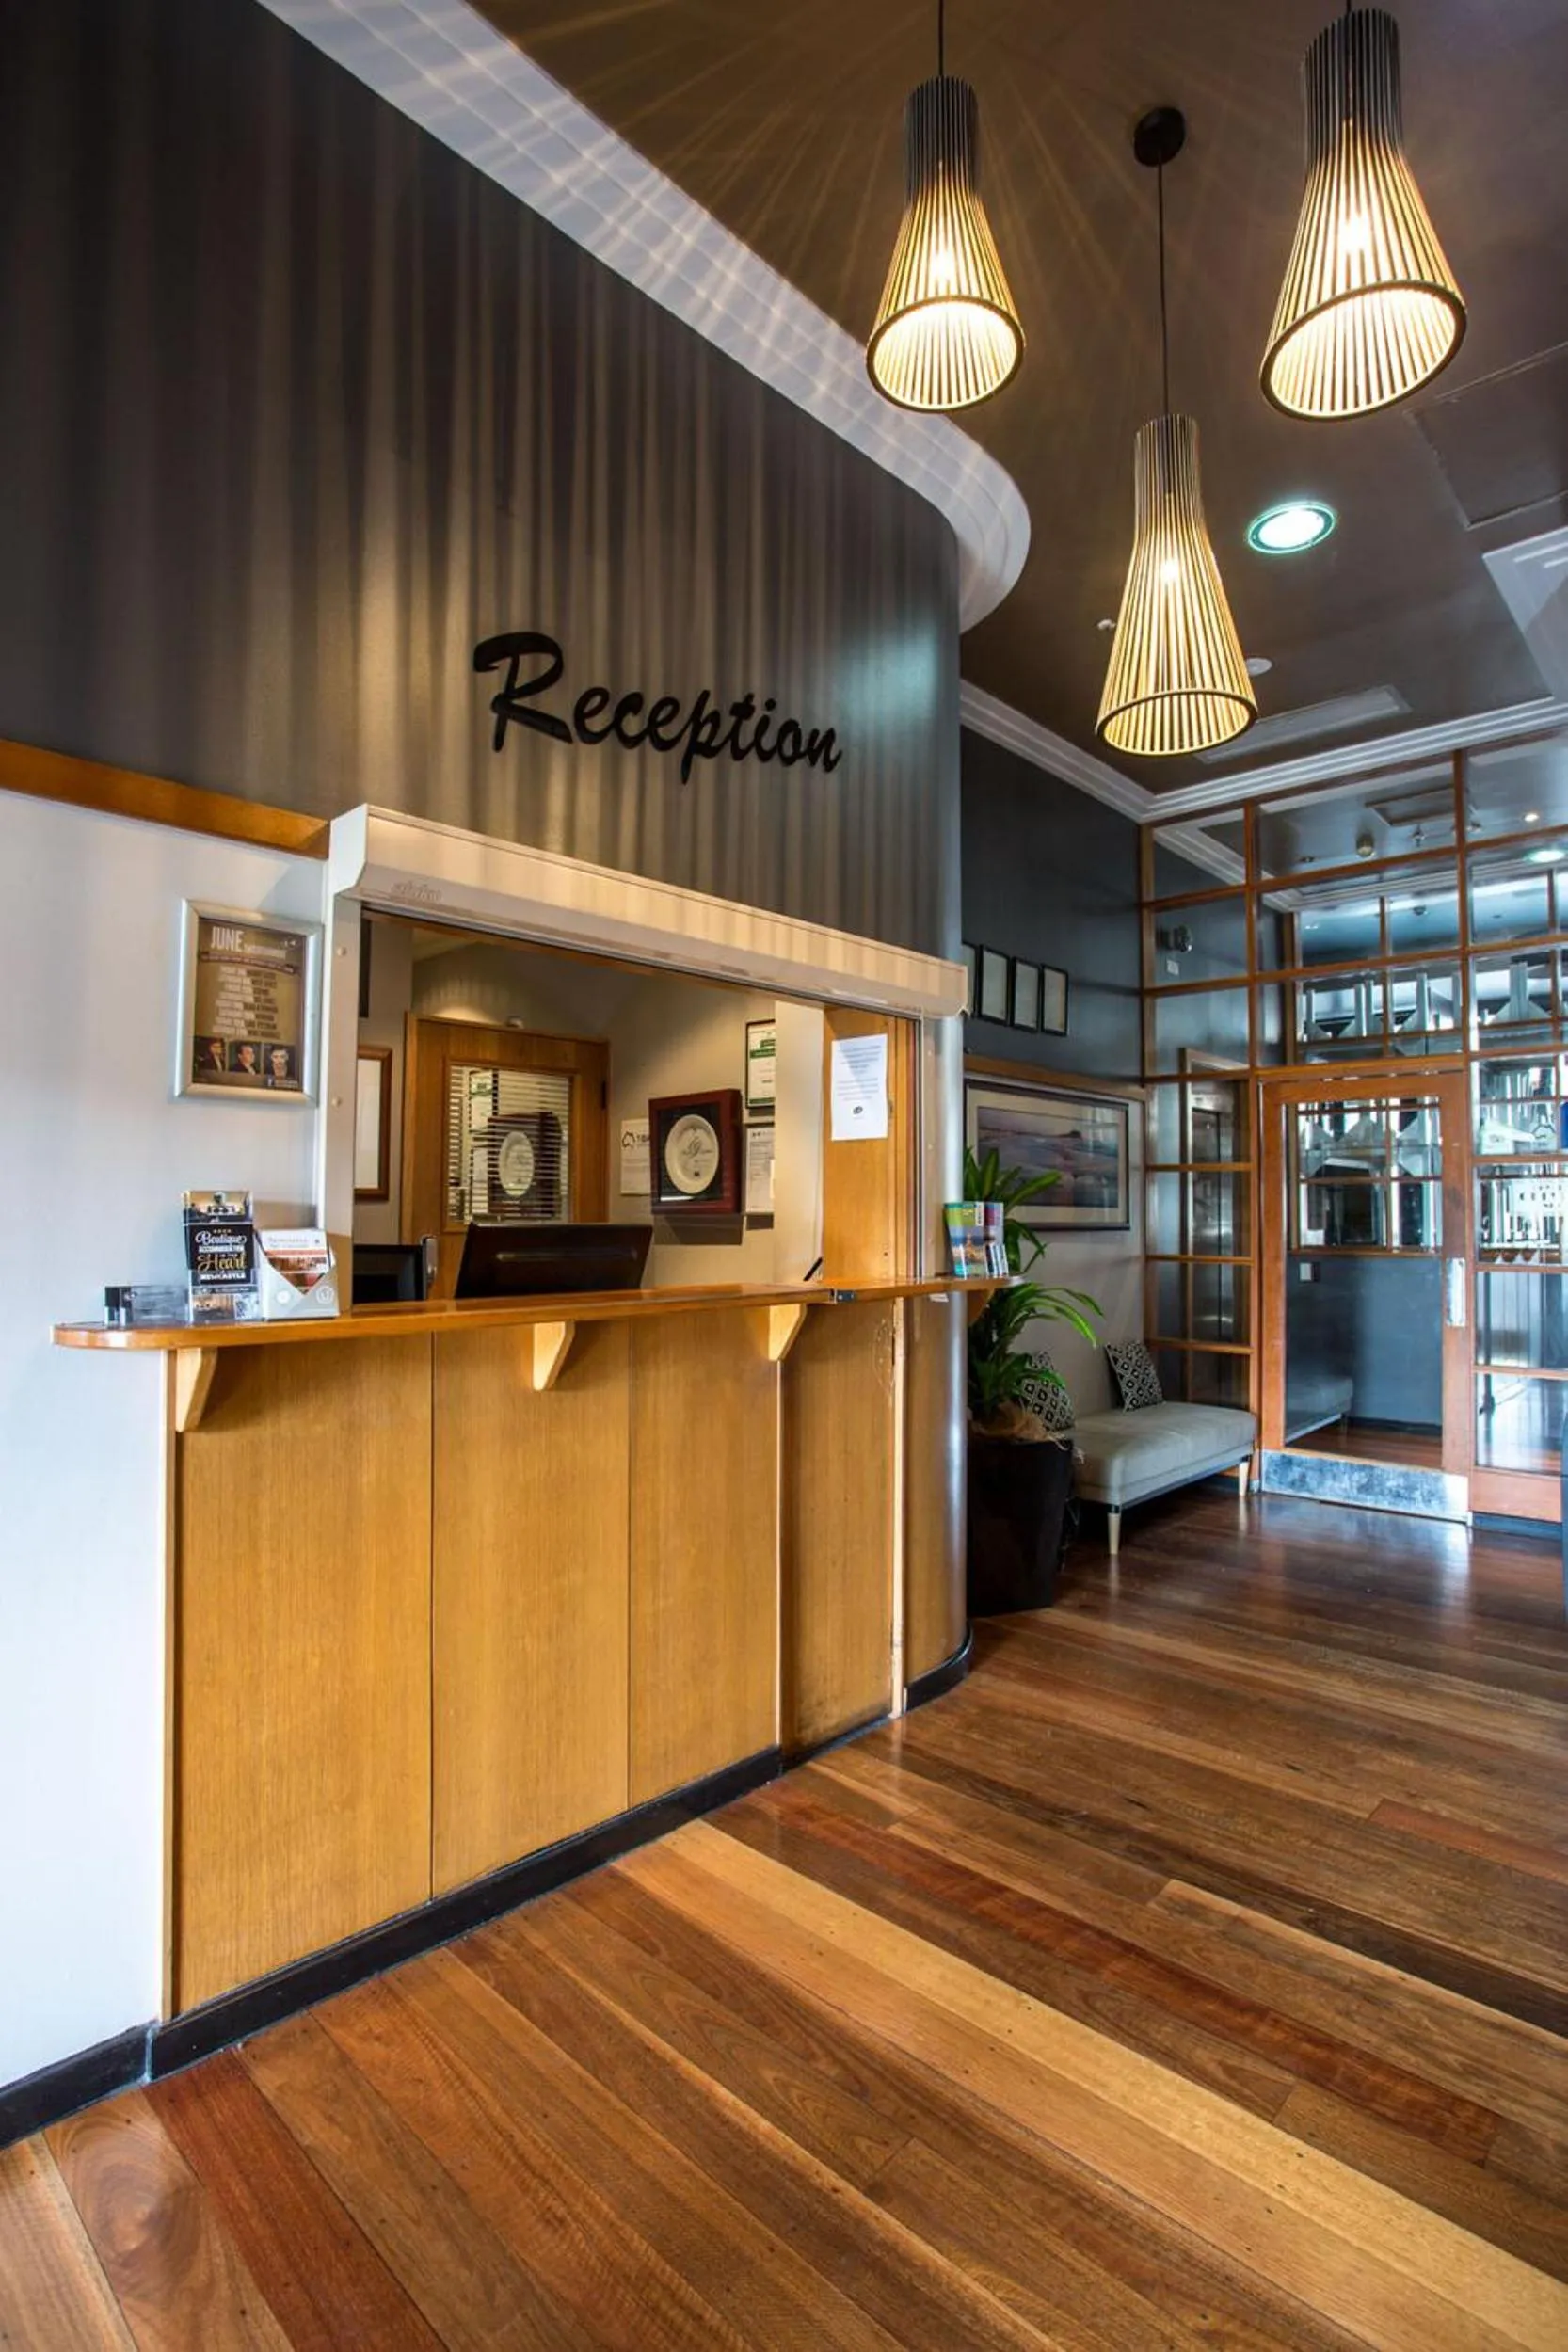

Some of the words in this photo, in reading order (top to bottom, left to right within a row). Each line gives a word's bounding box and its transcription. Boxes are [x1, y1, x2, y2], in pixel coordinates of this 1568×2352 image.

[473, 632, 843, 785] Reception
[211, 926, 245, 952] JUNE
[198, 1252, 246, 1272] Heart
